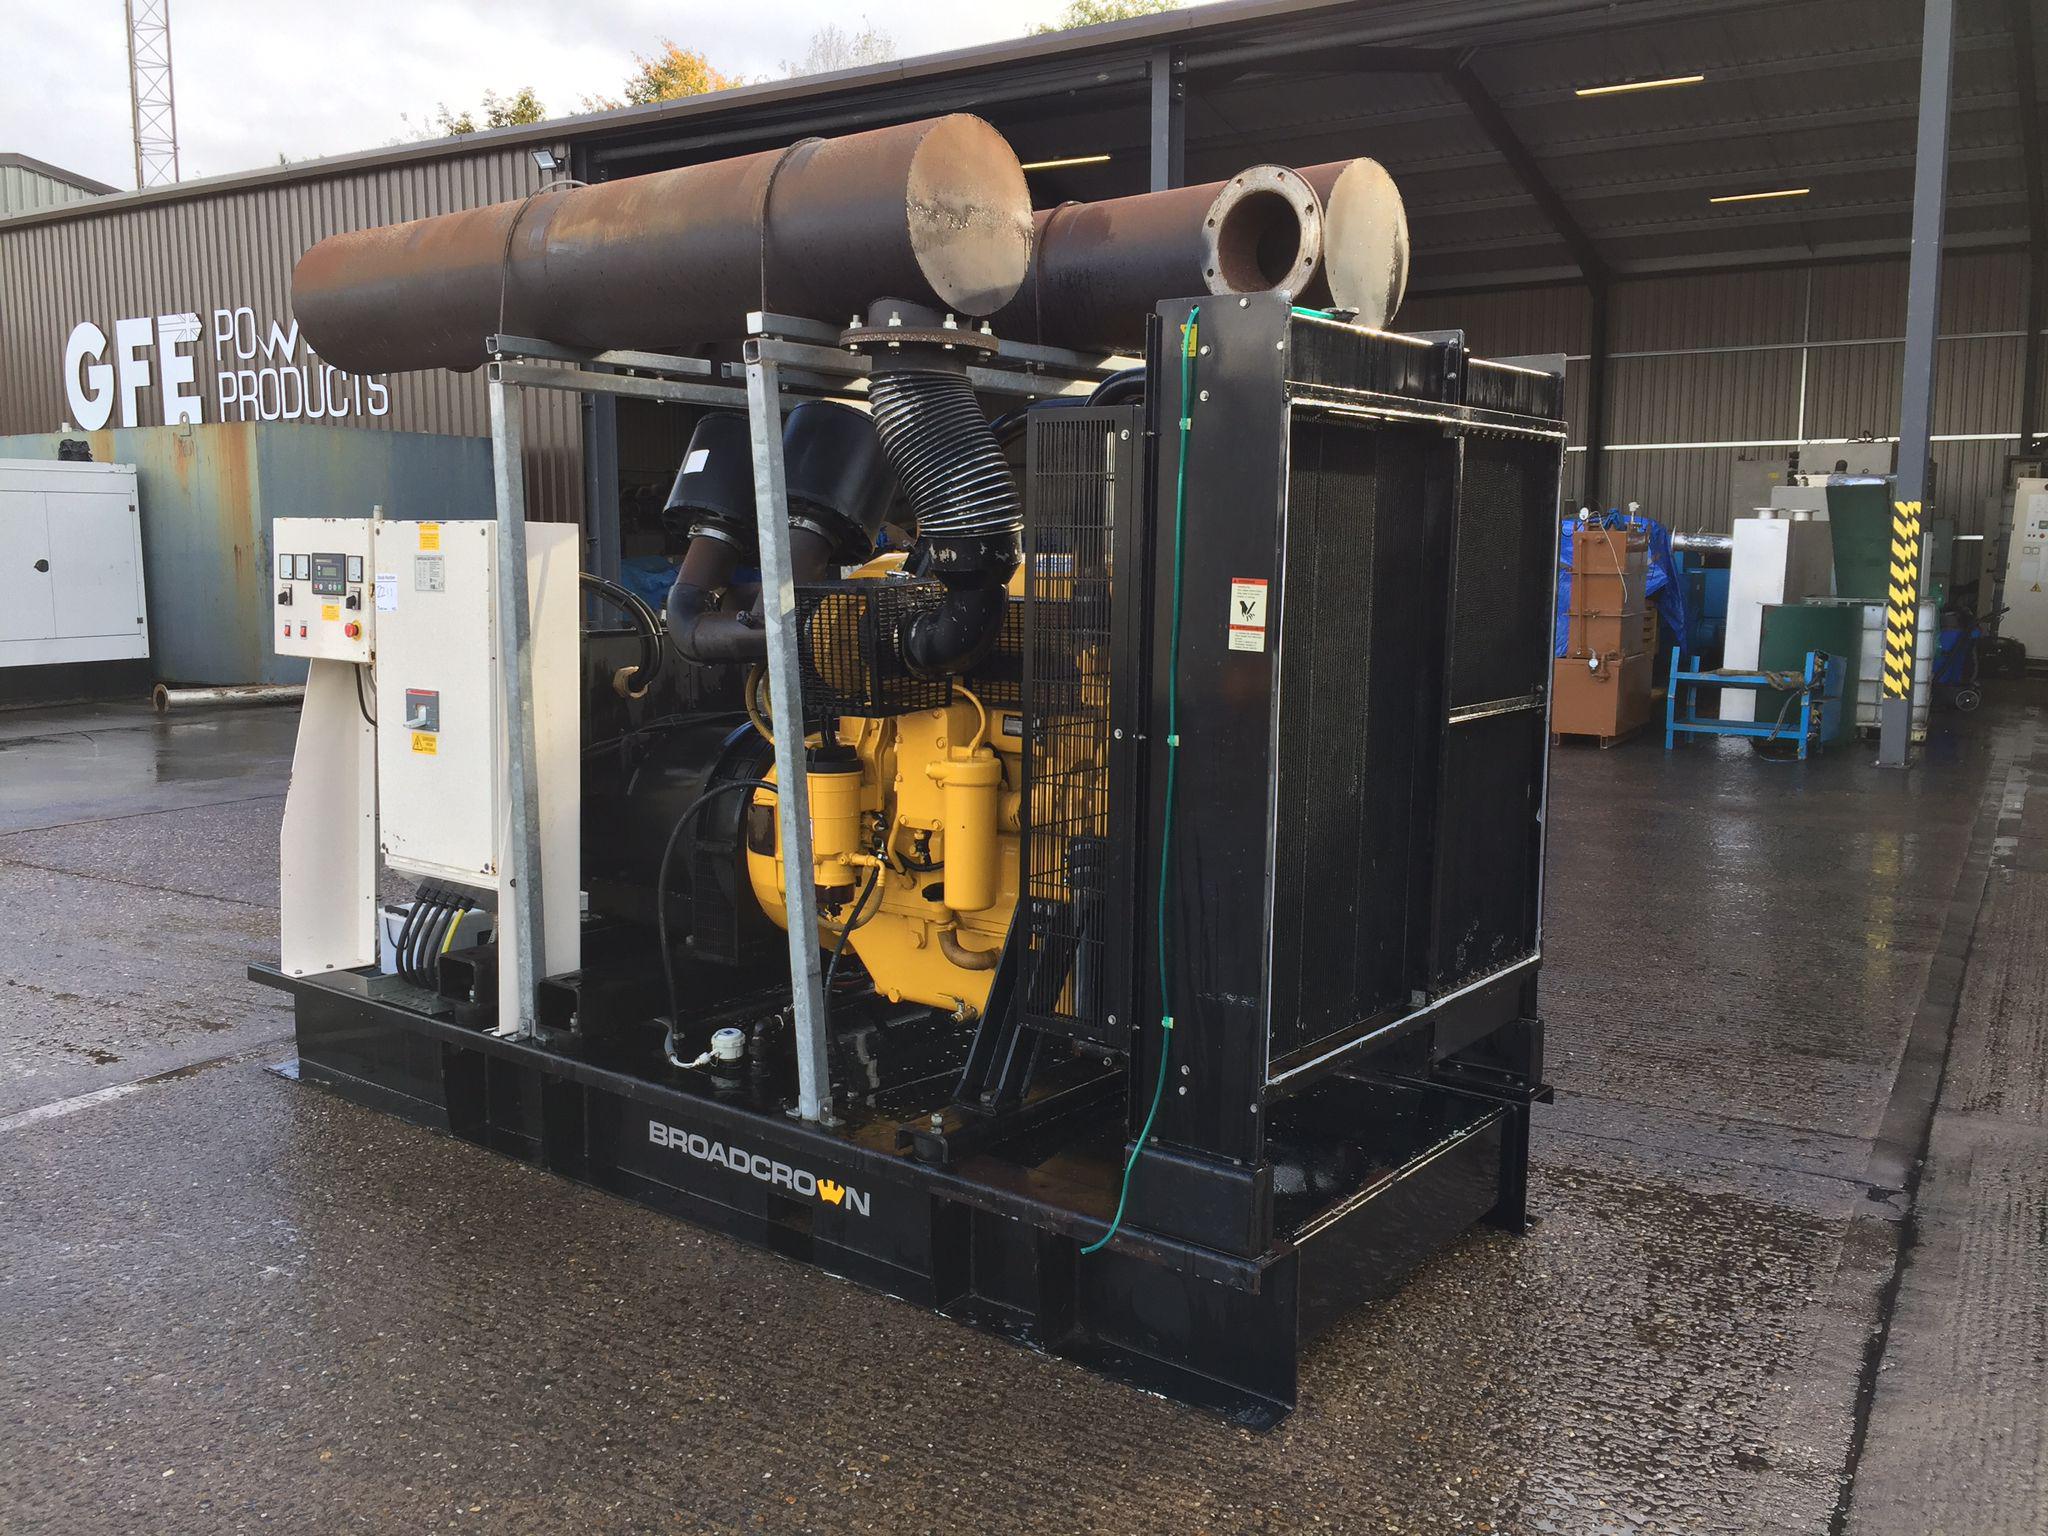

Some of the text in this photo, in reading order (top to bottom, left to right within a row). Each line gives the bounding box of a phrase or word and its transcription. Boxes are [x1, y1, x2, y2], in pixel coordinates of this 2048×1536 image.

[65, 312, 203, 432] GFE
[218, 365, 389, 422] PRODUCTS
[649, 1120, 871, 1217] BROADCROWN
